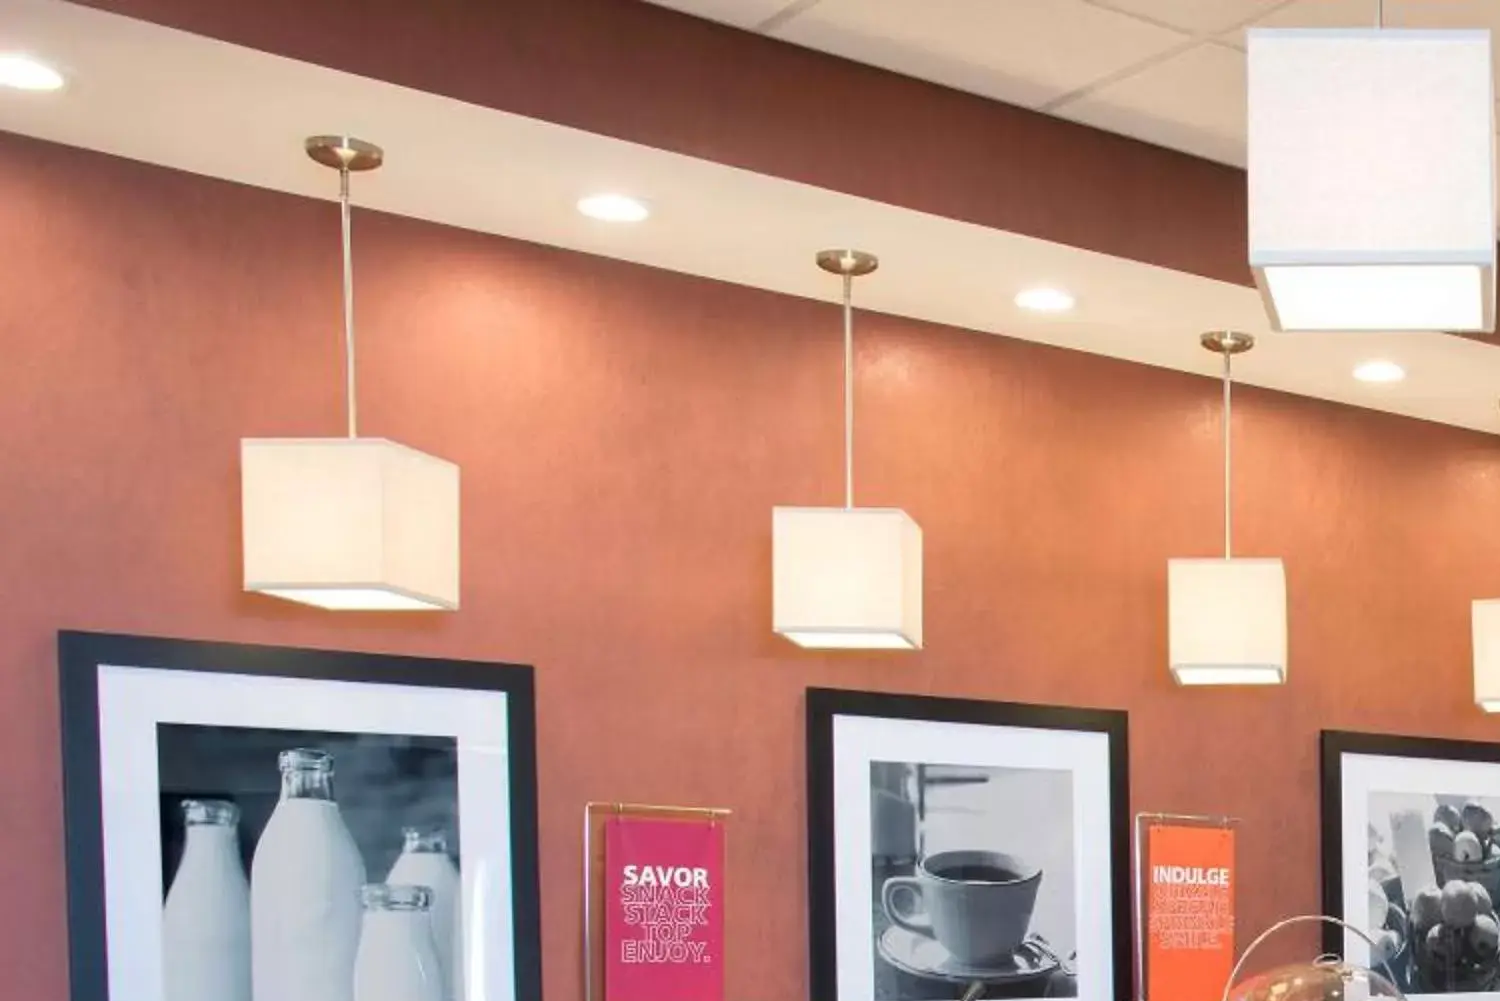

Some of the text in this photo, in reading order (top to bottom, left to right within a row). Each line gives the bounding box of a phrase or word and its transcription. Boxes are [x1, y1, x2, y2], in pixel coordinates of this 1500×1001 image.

[623, 865, 708, 888] SAVOR
[1153, 865, 1229, 887] INDULGE
[620, 884, 711, 905] SNACK
[623, 902, 709, 924] STACK
[641, 921, 693, 942] TOP
[621, 939, 711, 963] ENJOY.
